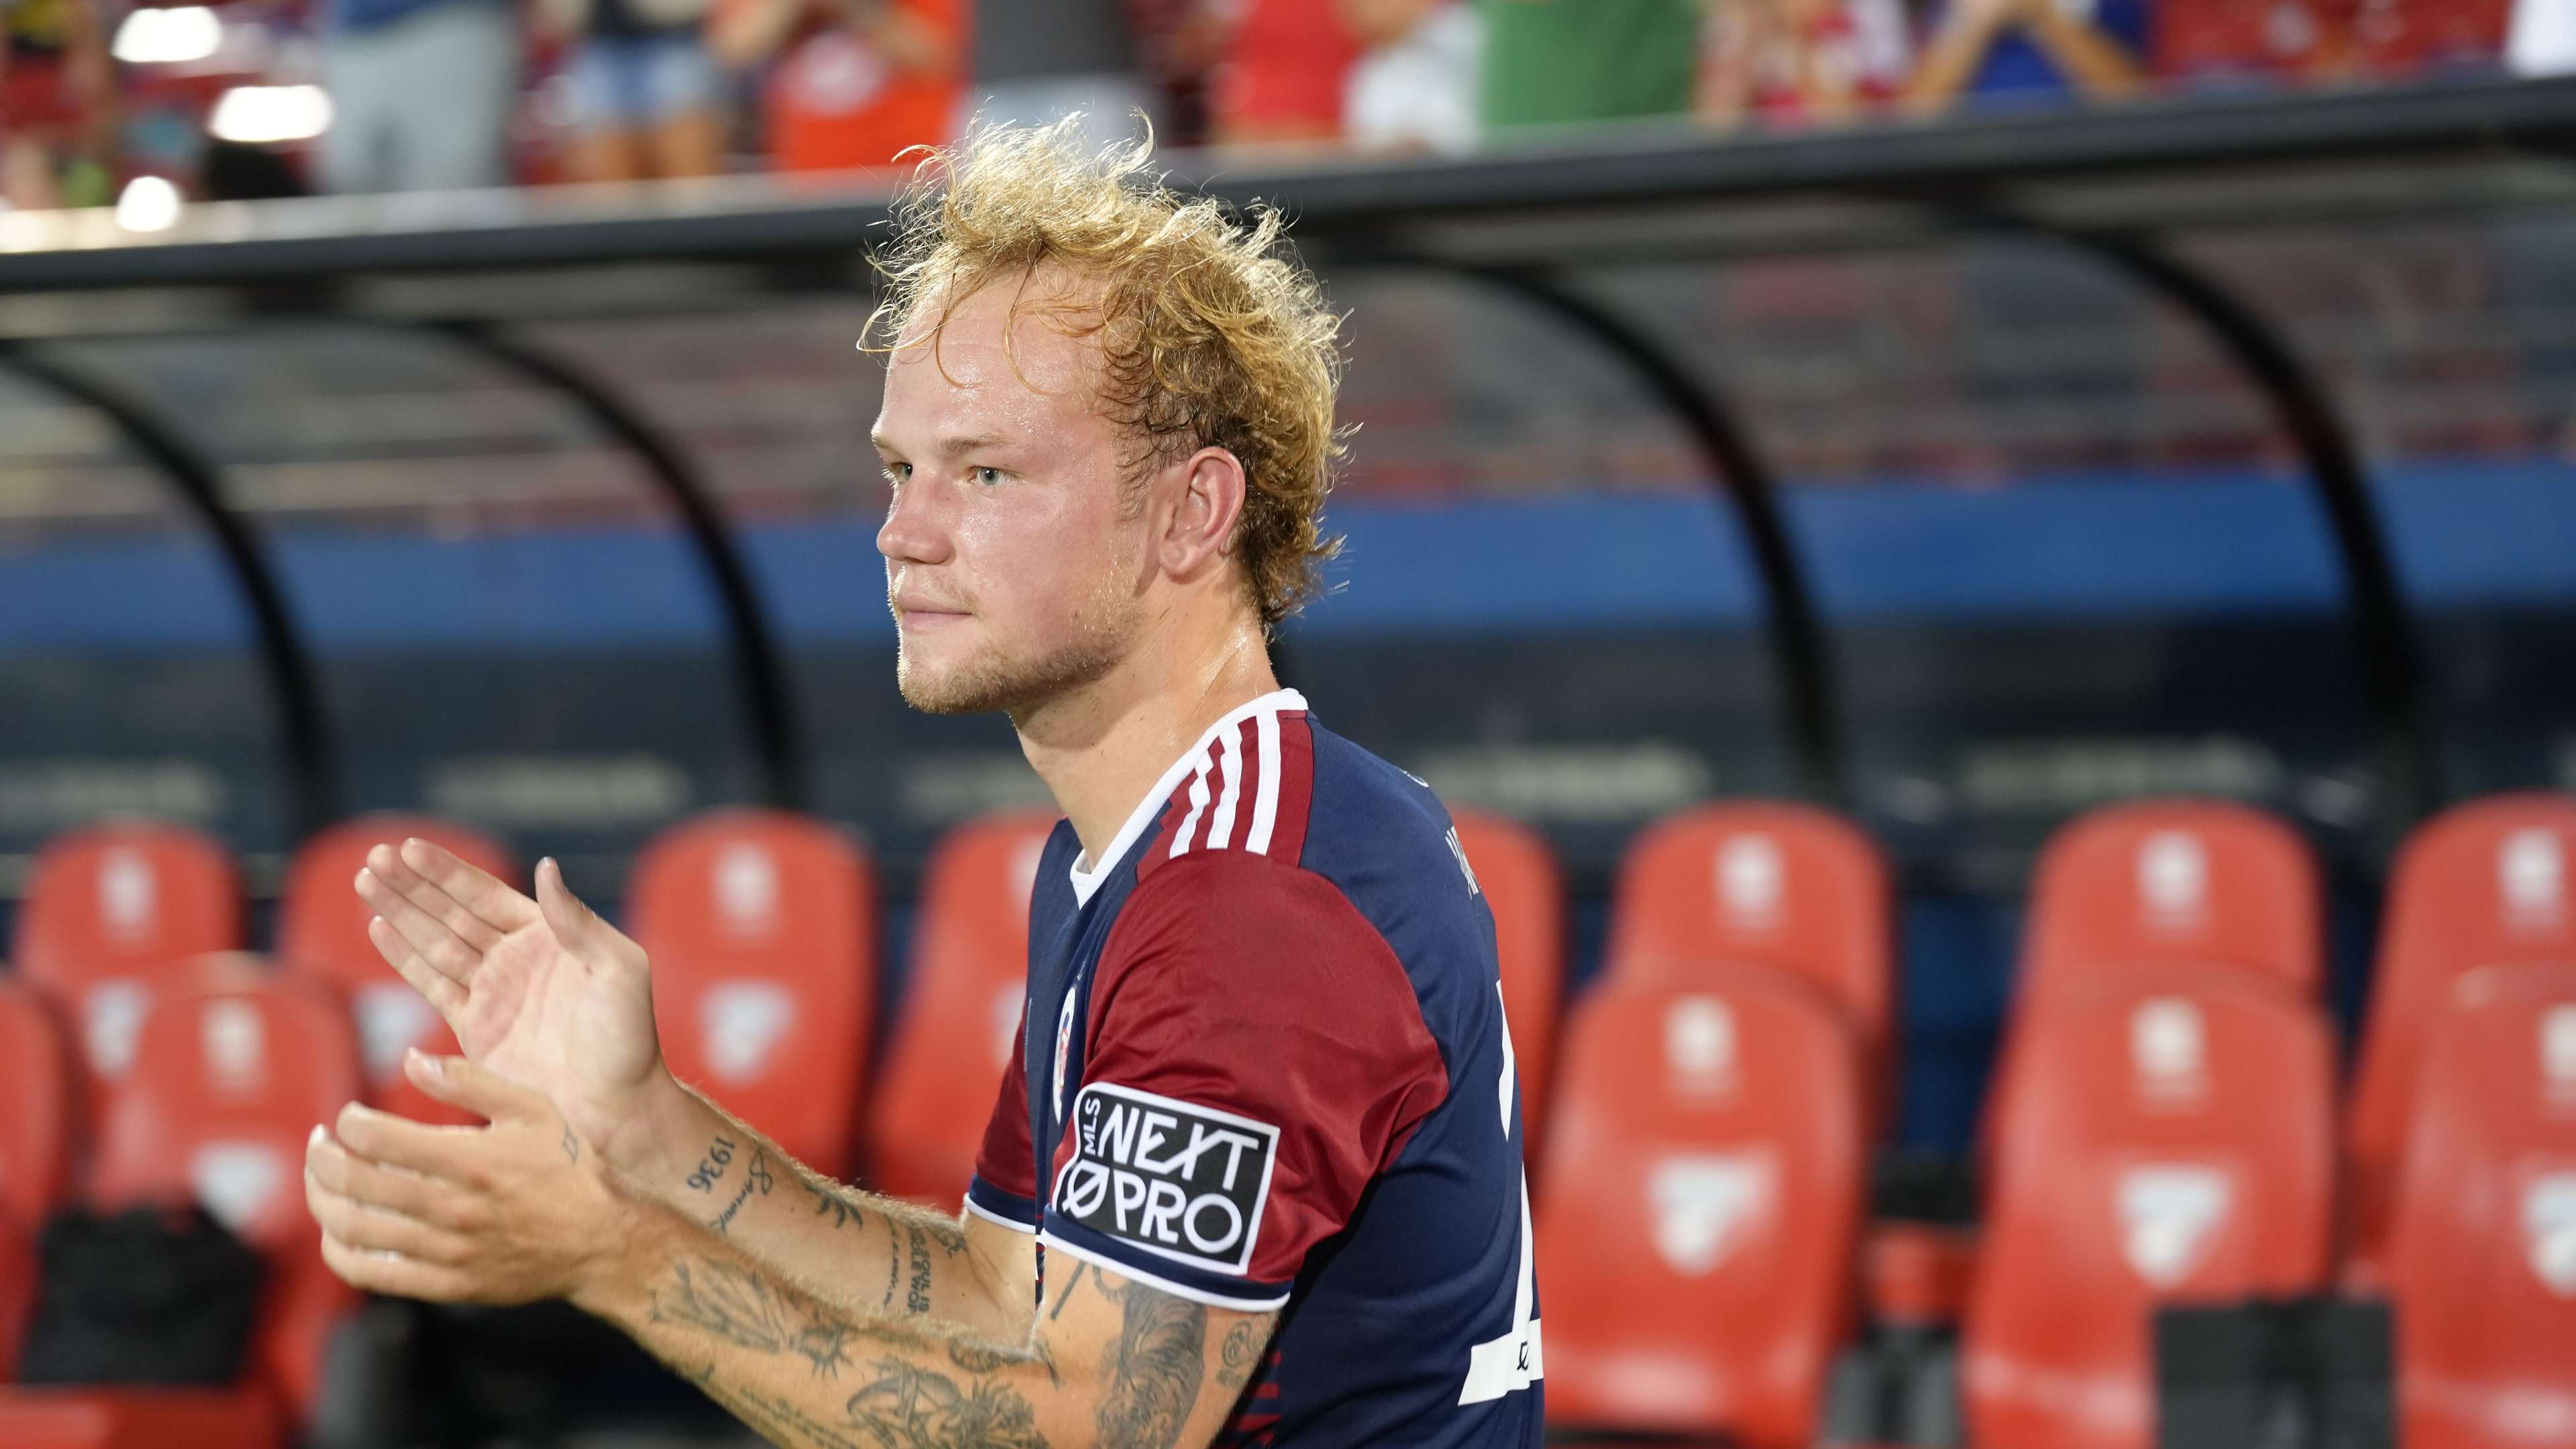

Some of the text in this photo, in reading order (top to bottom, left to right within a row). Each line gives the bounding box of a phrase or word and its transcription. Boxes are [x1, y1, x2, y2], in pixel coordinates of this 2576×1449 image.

[1083, 1097, 1102, 1155] MLS
[1097, 1103, 1260, 1191] NEXT
[687, 1136, 736, 1193] 1936
[1114, 1169, 1242, 1254] PRO
[921, 1250, 931, 1293] SOUL
